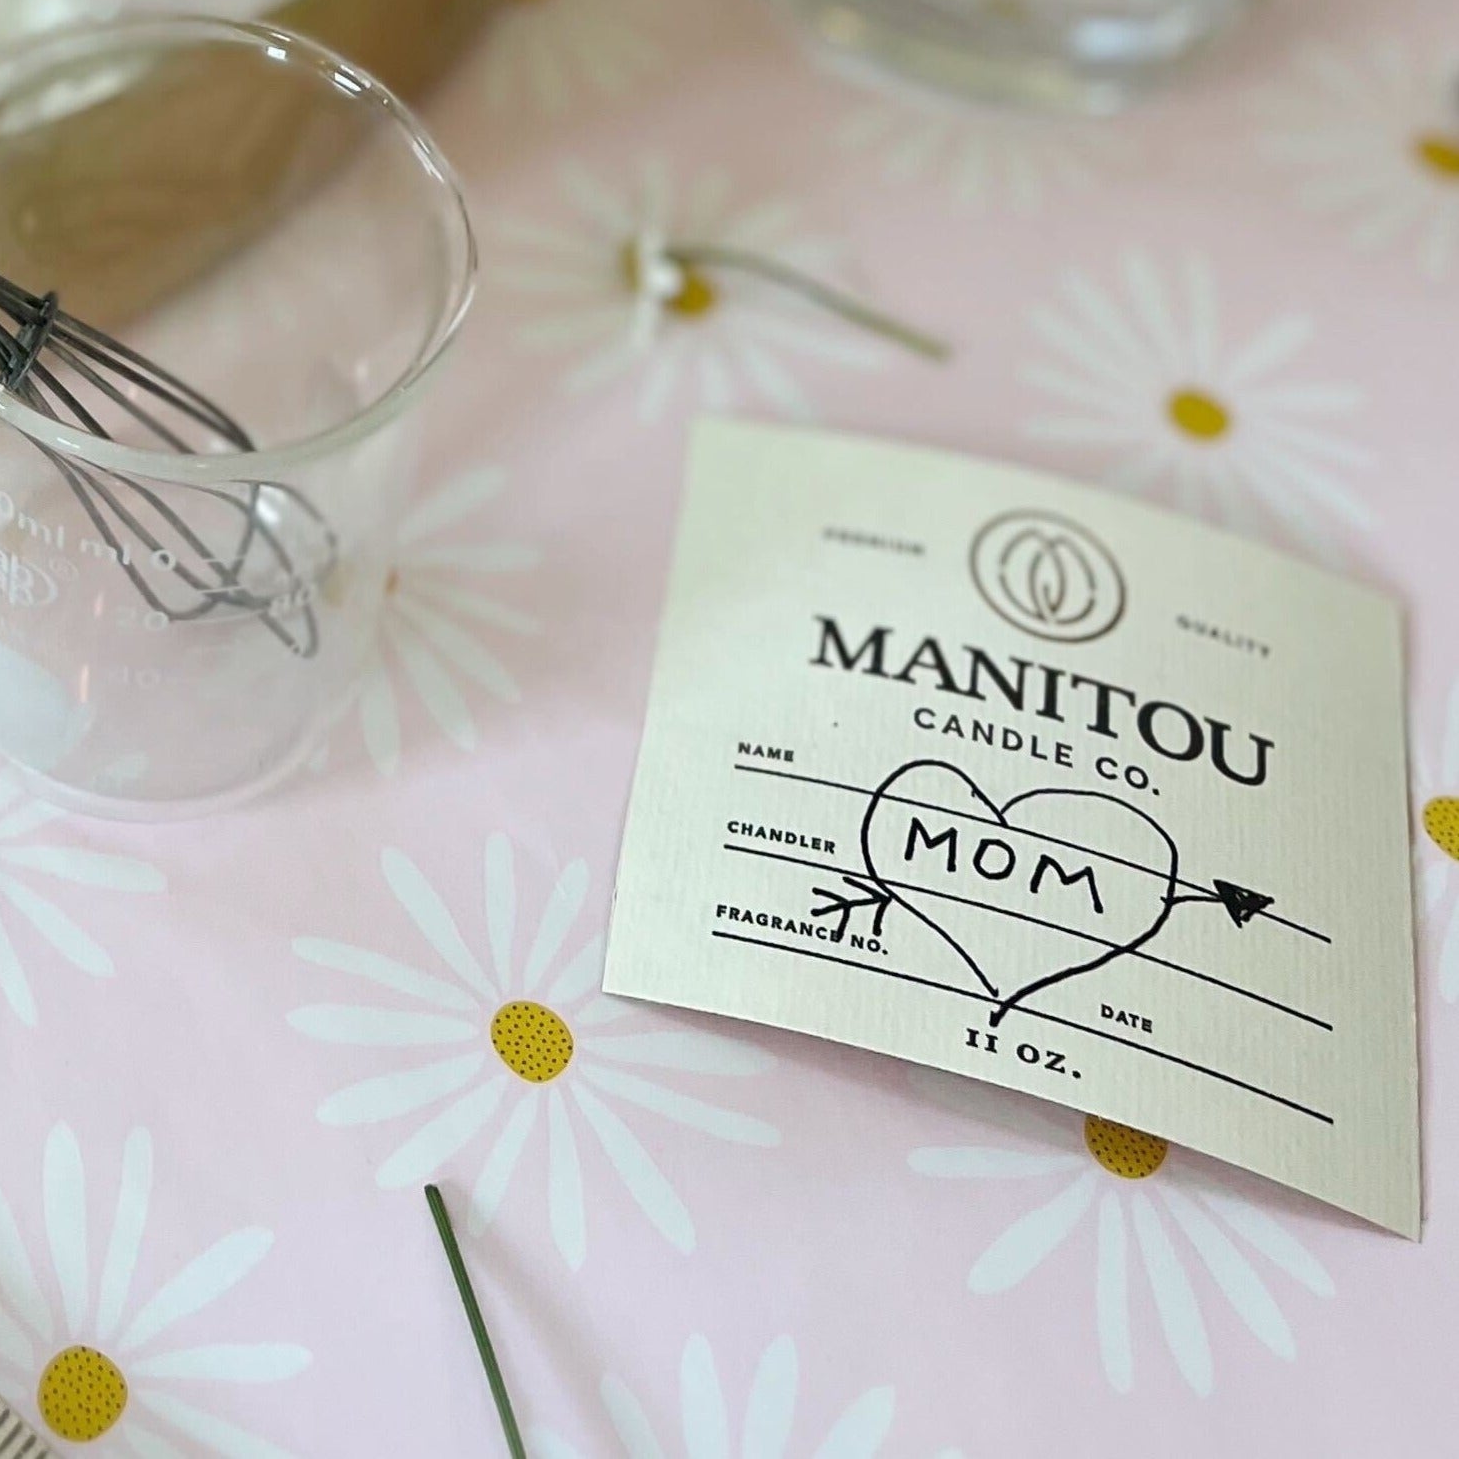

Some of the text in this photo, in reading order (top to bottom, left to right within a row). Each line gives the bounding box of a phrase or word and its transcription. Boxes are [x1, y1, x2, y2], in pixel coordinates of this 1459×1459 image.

[1175, 614, 1272, 659] QUALITY
[809, 615, 1275, 788] MANITOU
[737, 741, 794, 762] NAME
[914, 708, 1162, 797] CANDLE CO.
[727, 820, 837, 855] CHANDLER
[904, 817, 1103, 914] MOM
[716, 903, 889, 956] FRAGRANCE NO.
[1100, 1003, 1153, 1034] DATE
[1016, 1043, 1082, 1079] OZ.
